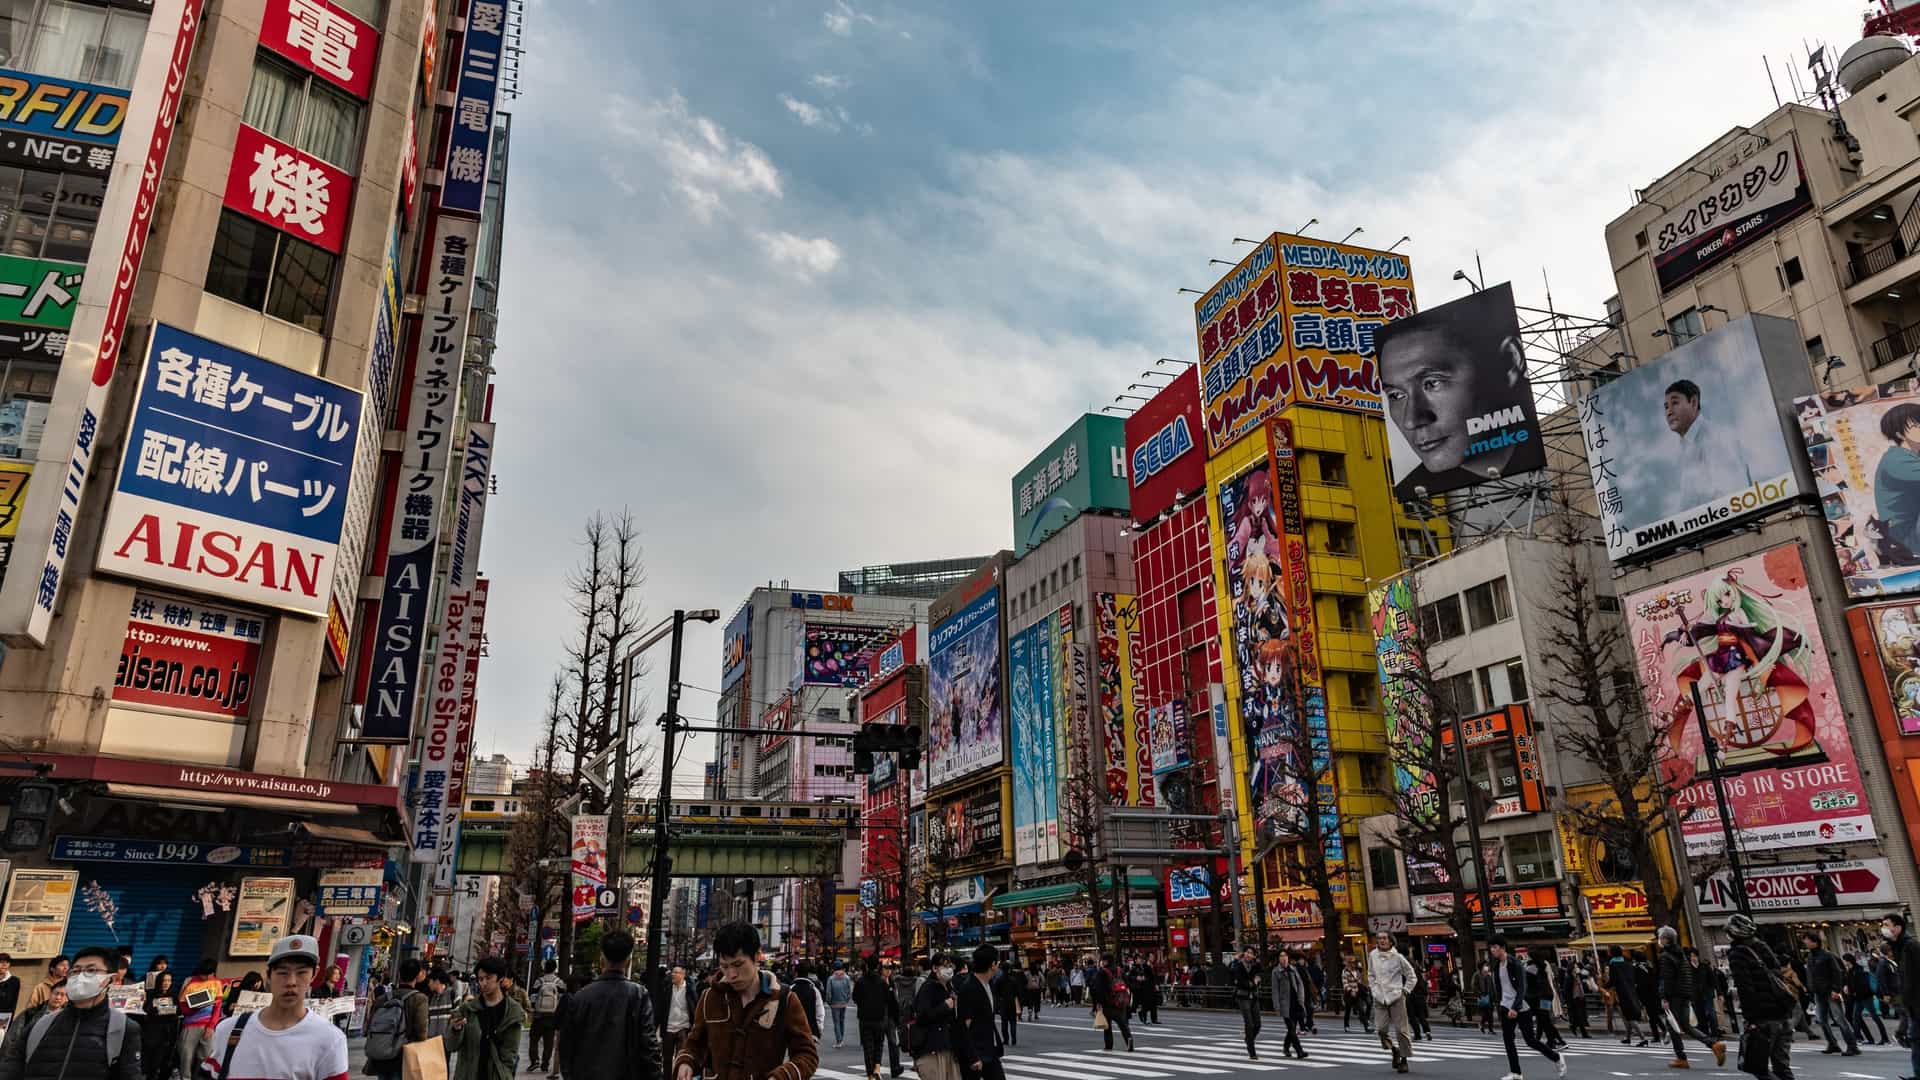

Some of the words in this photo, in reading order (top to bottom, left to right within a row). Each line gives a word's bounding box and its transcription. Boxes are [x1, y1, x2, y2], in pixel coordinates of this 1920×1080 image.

[286, 0, 358, 81] 電
[449, 1, 503, 183] 愛三電機
[249, 143, 331, 235] 機
[1659, 150, 1788, 250] メイドカジノ
[1696, 239, 1724, 260] POKER
[1735, 214, 1763, 237] STARS
[1201, 270, 1279, 363] 激安販売
[157, 347, 349, 442] 各種ケーブル
[1204, 312, 1282, 407] 高額買取
[1133, 414, 1194, 488] SEGA
[1465, 405, 1526, 436] DMM
[136, 429, 336, 517] 配線パーツ
[464, 430, 490, 507] AKKY
[1579, 392, 1634, 556] 次は太陽か。
[1729, 478, 1789, 513] solar
[114, 514, 324, 597] AISAN
[376, 563, 420, 718] AISAN
[427, 697, 457, 762] Shop
[180, 769, 331, 796] http://www.aisan.co.jp
[1753, 774, 1774, 794] IN
[1783, 763, 1850, 791] STORE
[124, 847, 155, 860] Since
[155, 843, 199, 861] 1949
[1744, 875, 1809, 897] COMIC
[1751, 897, 1801, 908] kihabara
